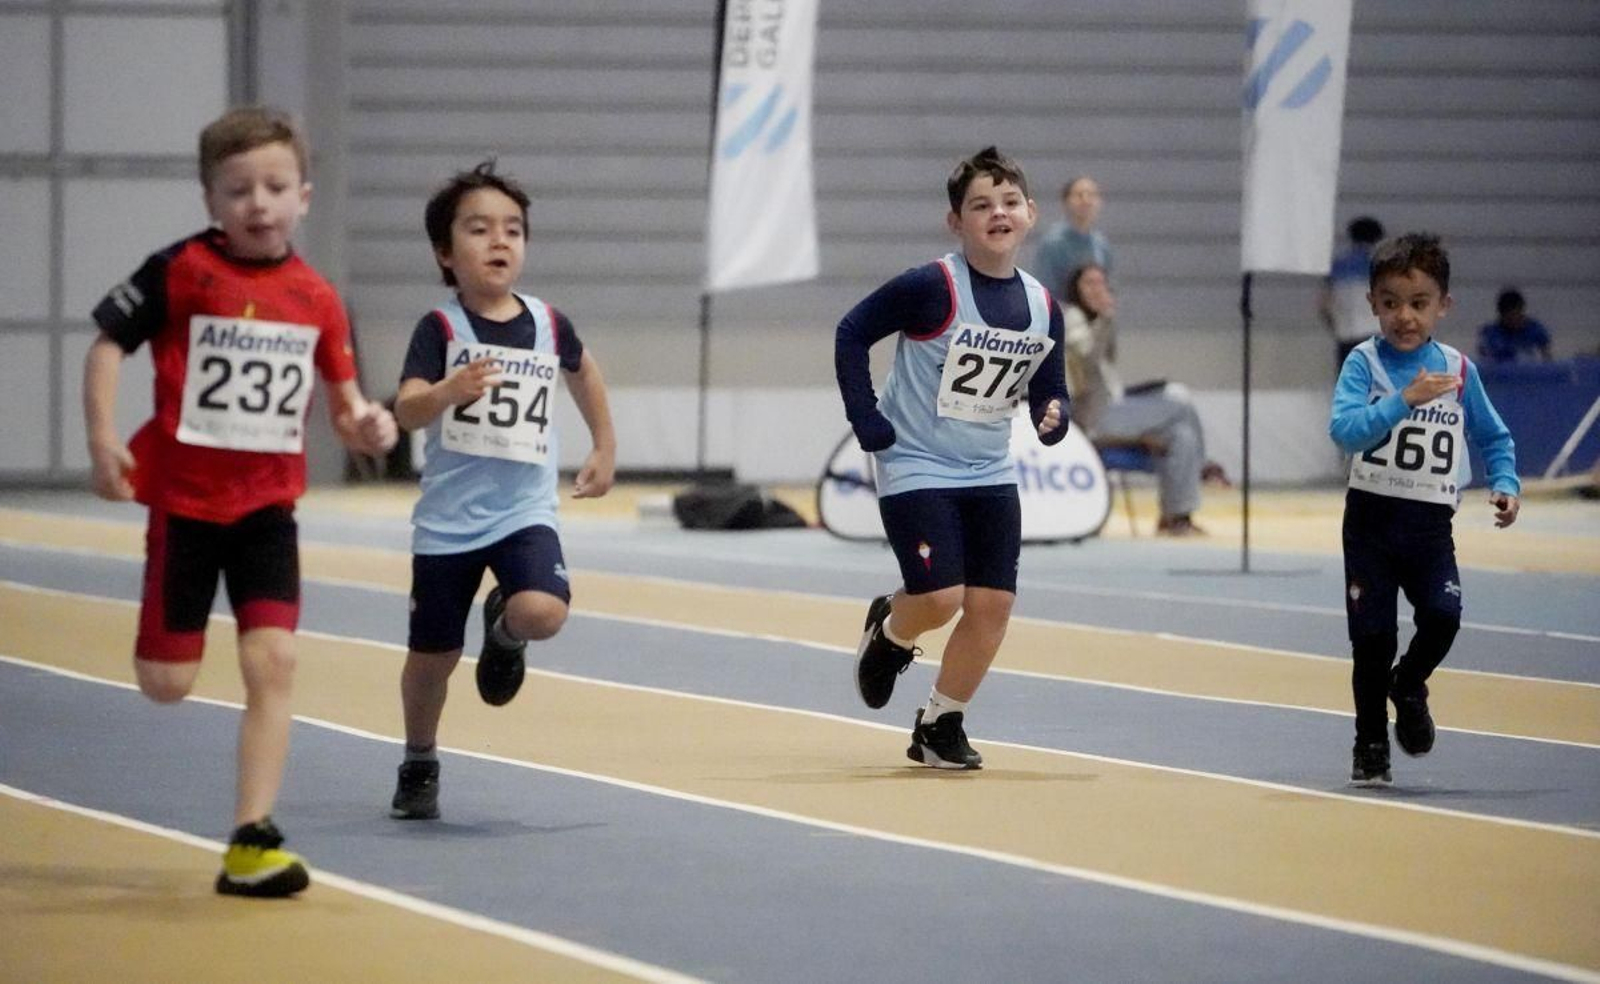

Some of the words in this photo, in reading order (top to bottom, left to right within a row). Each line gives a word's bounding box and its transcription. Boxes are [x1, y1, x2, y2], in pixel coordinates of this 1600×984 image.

[757, 0, 783, 70] GAL
[955, 328, 1045, 356] Atlántico
[197, 356, 303, 416] 232
[951, 352, 1031, 399] 272
[1407, 404, 1459, 426] ntico
[1014, 449, 1096, 492] tico
[1362, 426, 1454, 476] 269
